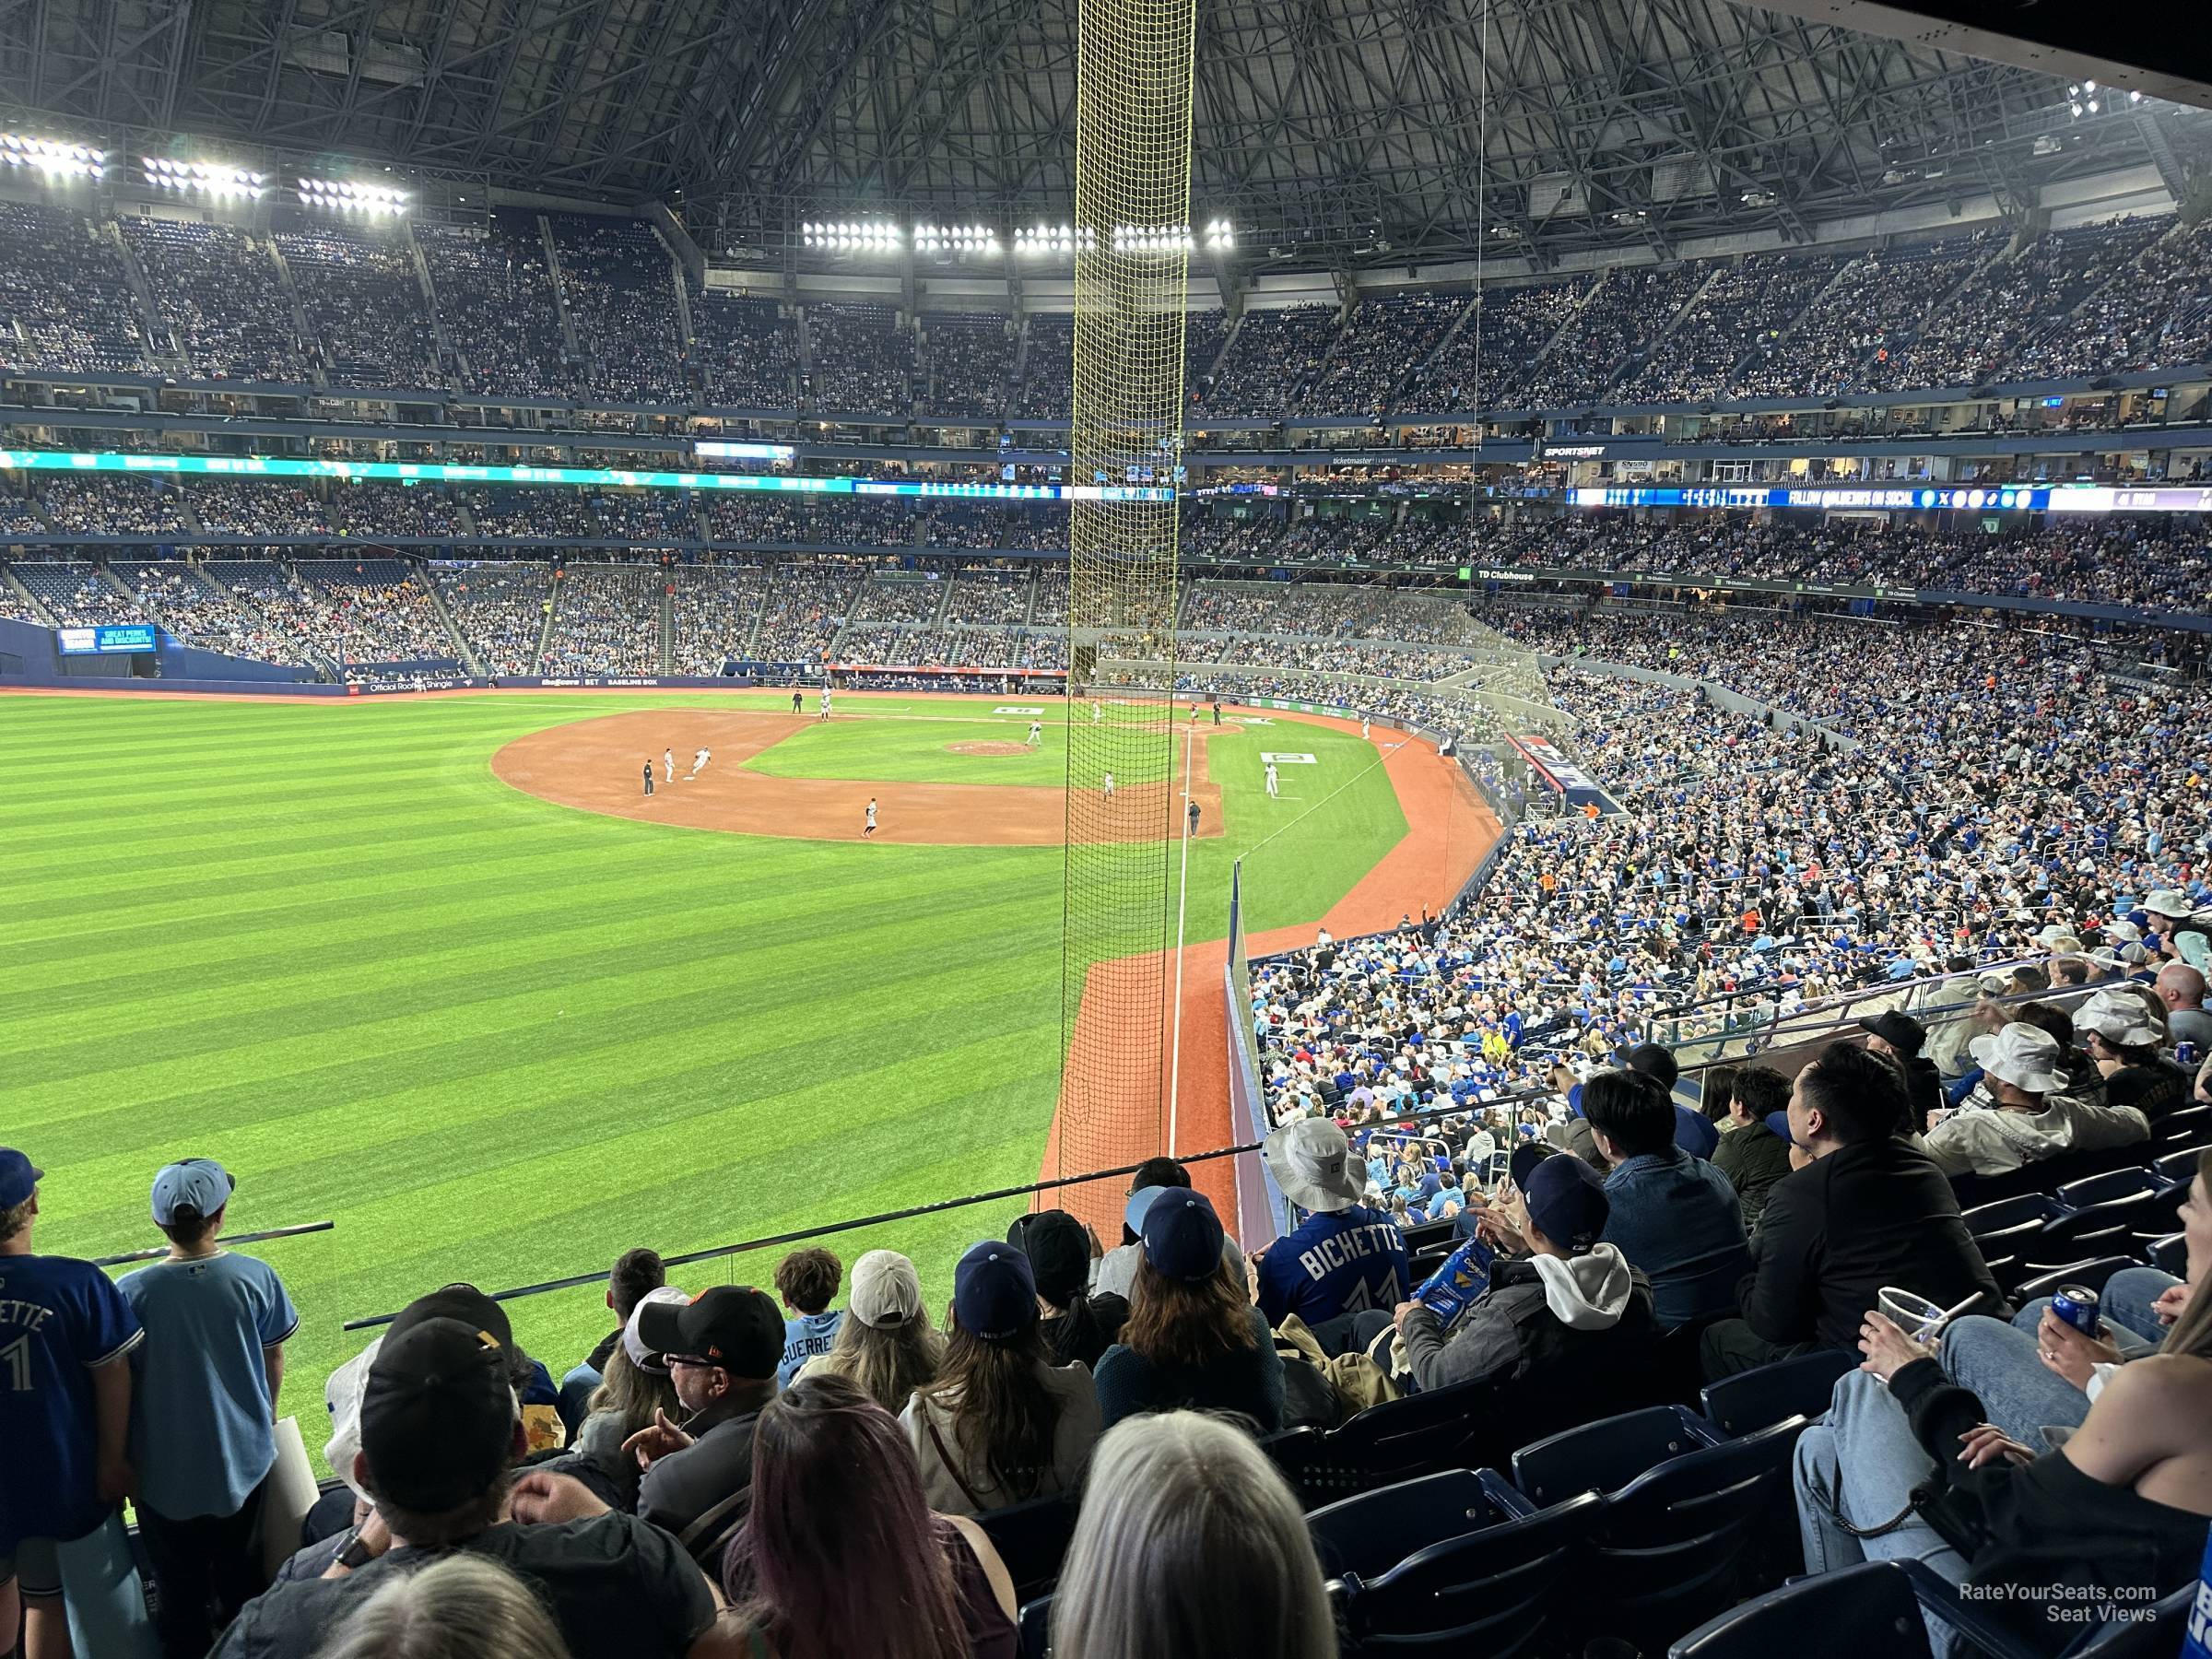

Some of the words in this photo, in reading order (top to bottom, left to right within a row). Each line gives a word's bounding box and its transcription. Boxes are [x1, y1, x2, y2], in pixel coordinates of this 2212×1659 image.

[1545, 447, 1605, 456] SPORTSNET
[1789, 490, 1822, 505] FOLLOW
[1872, 491, 1885, 505] ON
[1885, 491, 1914, 506] SOCIAL
[1478, 571, 1490, 579] TD
[1491, 571, 1535, 581] Clubhouse
[371, 684, 396, 692] Official
[427, 680, 453, 689] Shingle
[1299, 1224, 1403, 1281] BICHETTE
